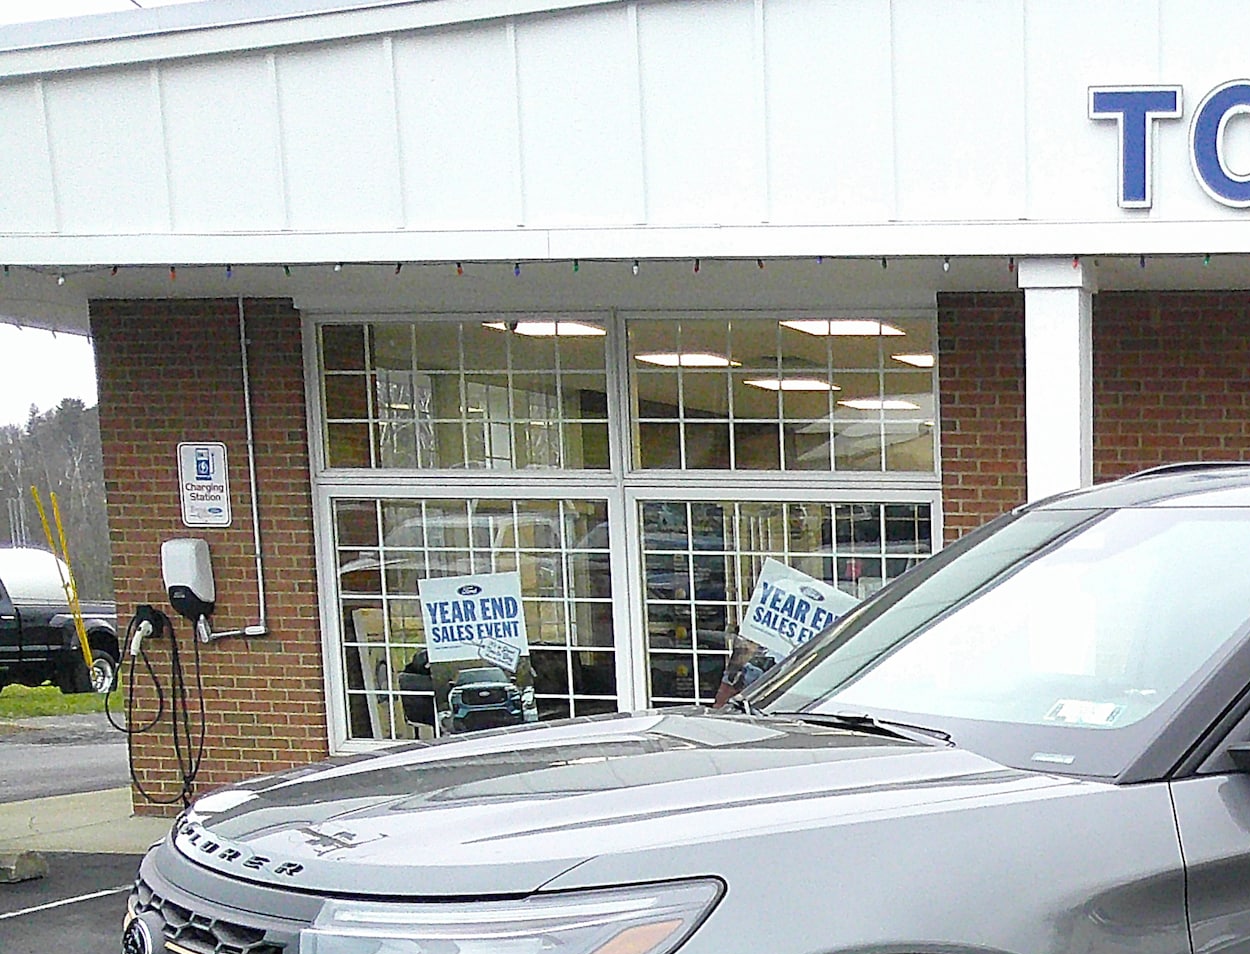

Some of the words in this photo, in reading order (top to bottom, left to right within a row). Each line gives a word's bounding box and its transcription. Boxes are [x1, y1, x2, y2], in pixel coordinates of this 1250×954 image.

[185, 482, 225, 493] Charging
[189, 492, 221, 501] Station
[426, 599, 477, 625] YEAR
[479, 596, 519, 621] END
[759, 581, 811, 624] YEAR
[811, 607, 840, 631] EN
[431, 624, 475, 643] SALES
[476, 620, 520, 640] EVENT
[753, 607, 797, 637] SALES
